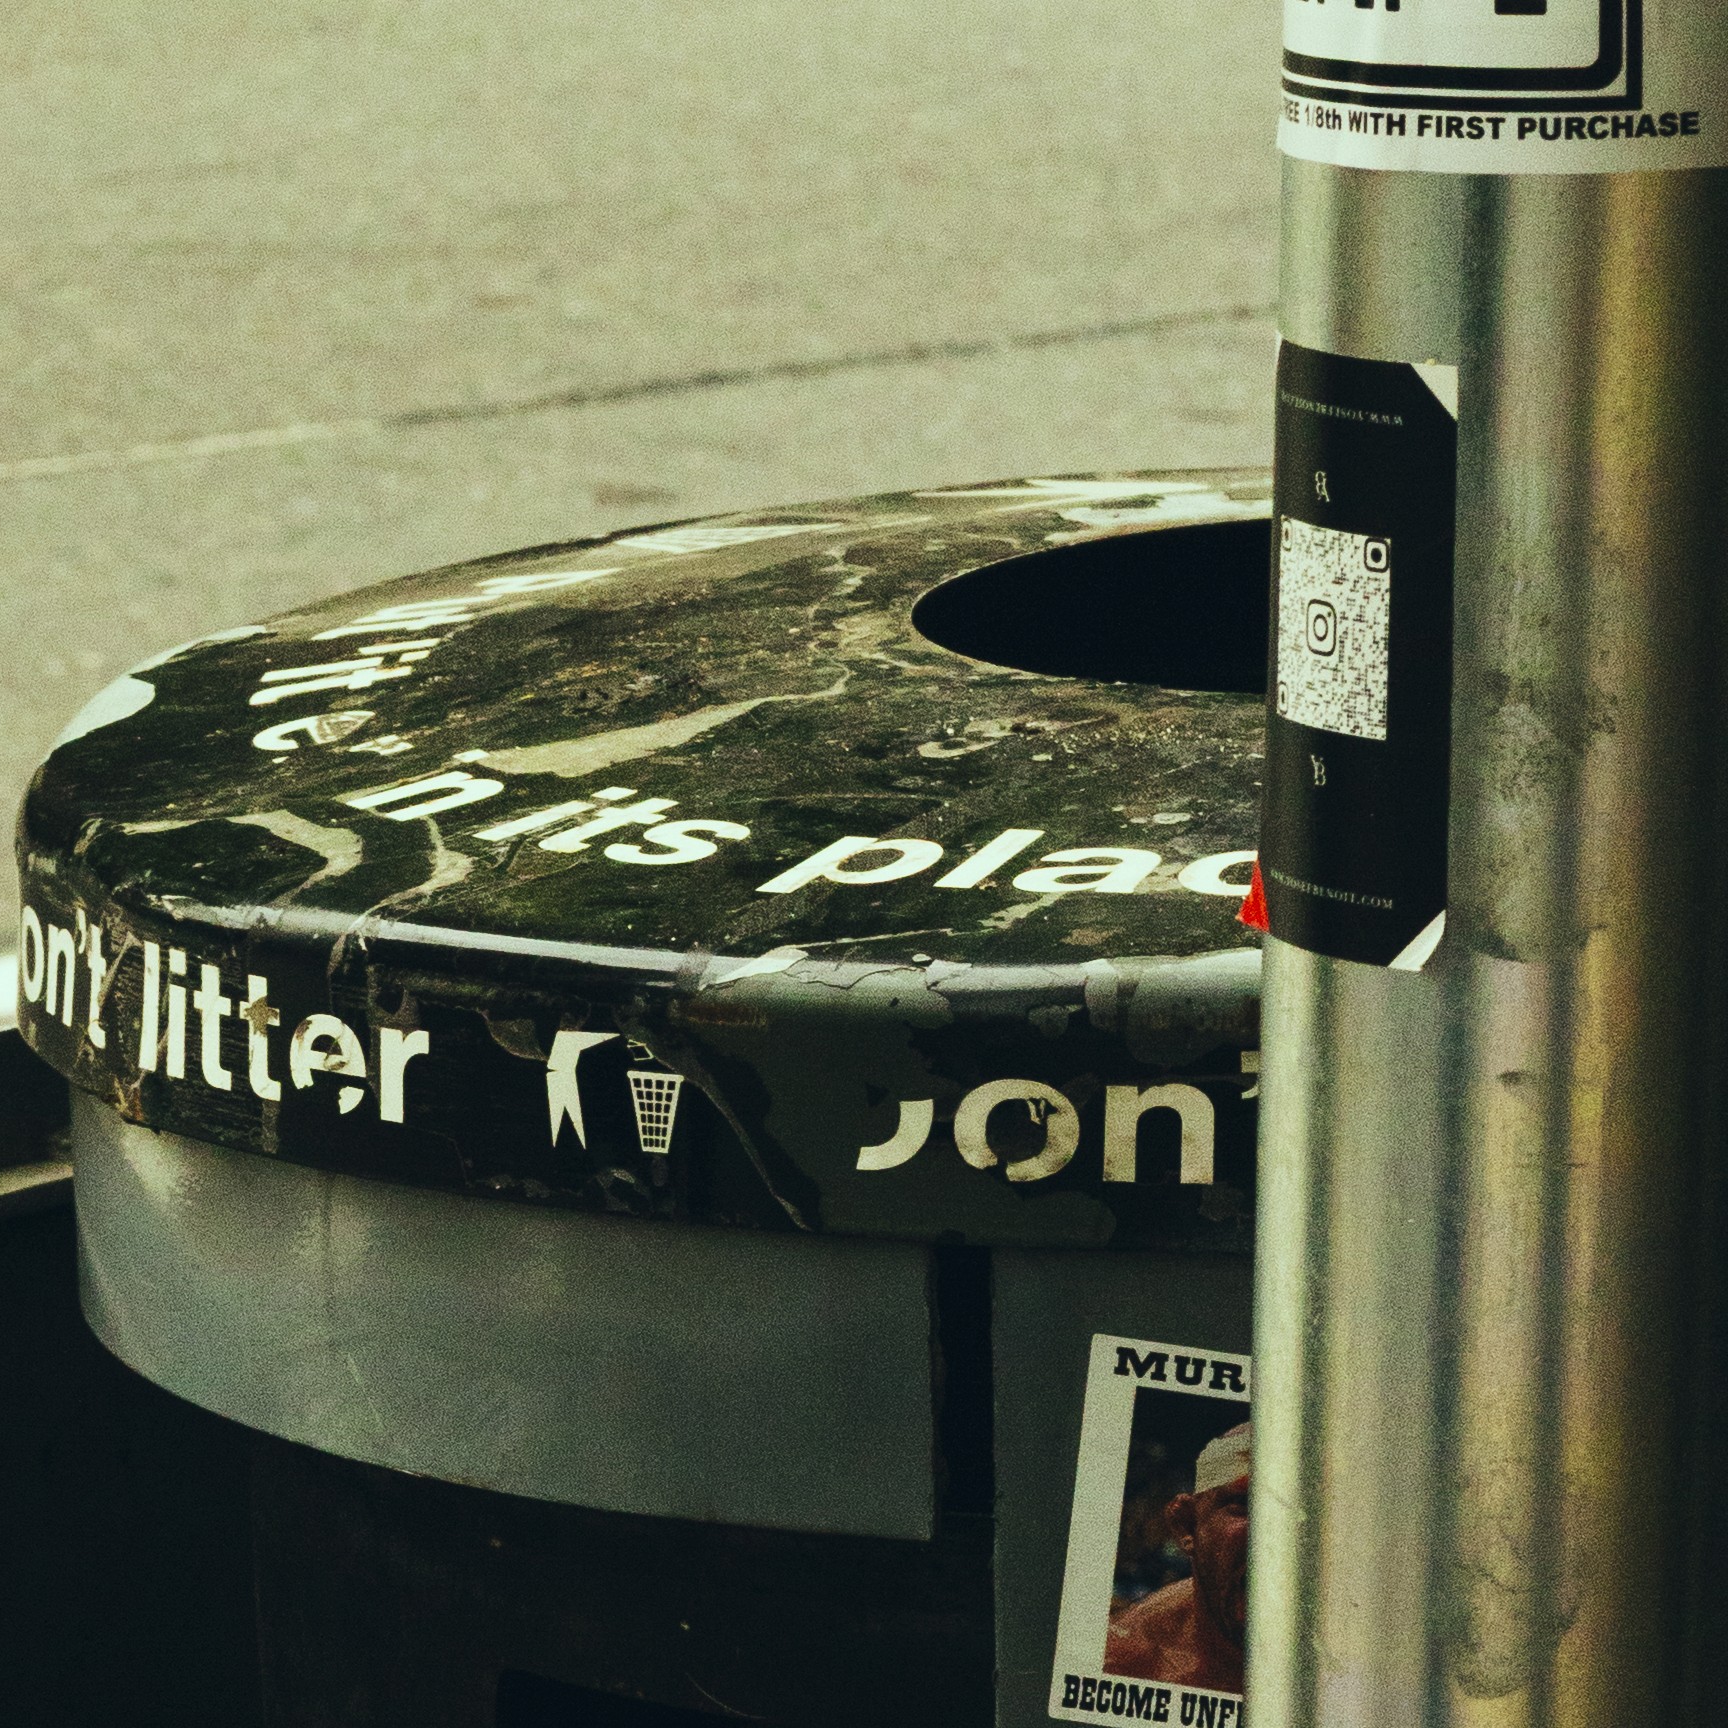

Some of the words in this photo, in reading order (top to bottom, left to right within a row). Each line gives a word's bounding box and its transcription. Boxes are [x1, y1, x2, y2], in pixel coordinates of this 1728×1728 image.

[1348, 109, 1406, 136] WITH
[1418, 113, 1504, 140] FIRST
[1518, 111, 1700, 141] PURCHASE
[472, 786, 751, 866] its
[138, 940, 430, 1124] litter
[1061, 1673, 1171, 1723] BECOME
